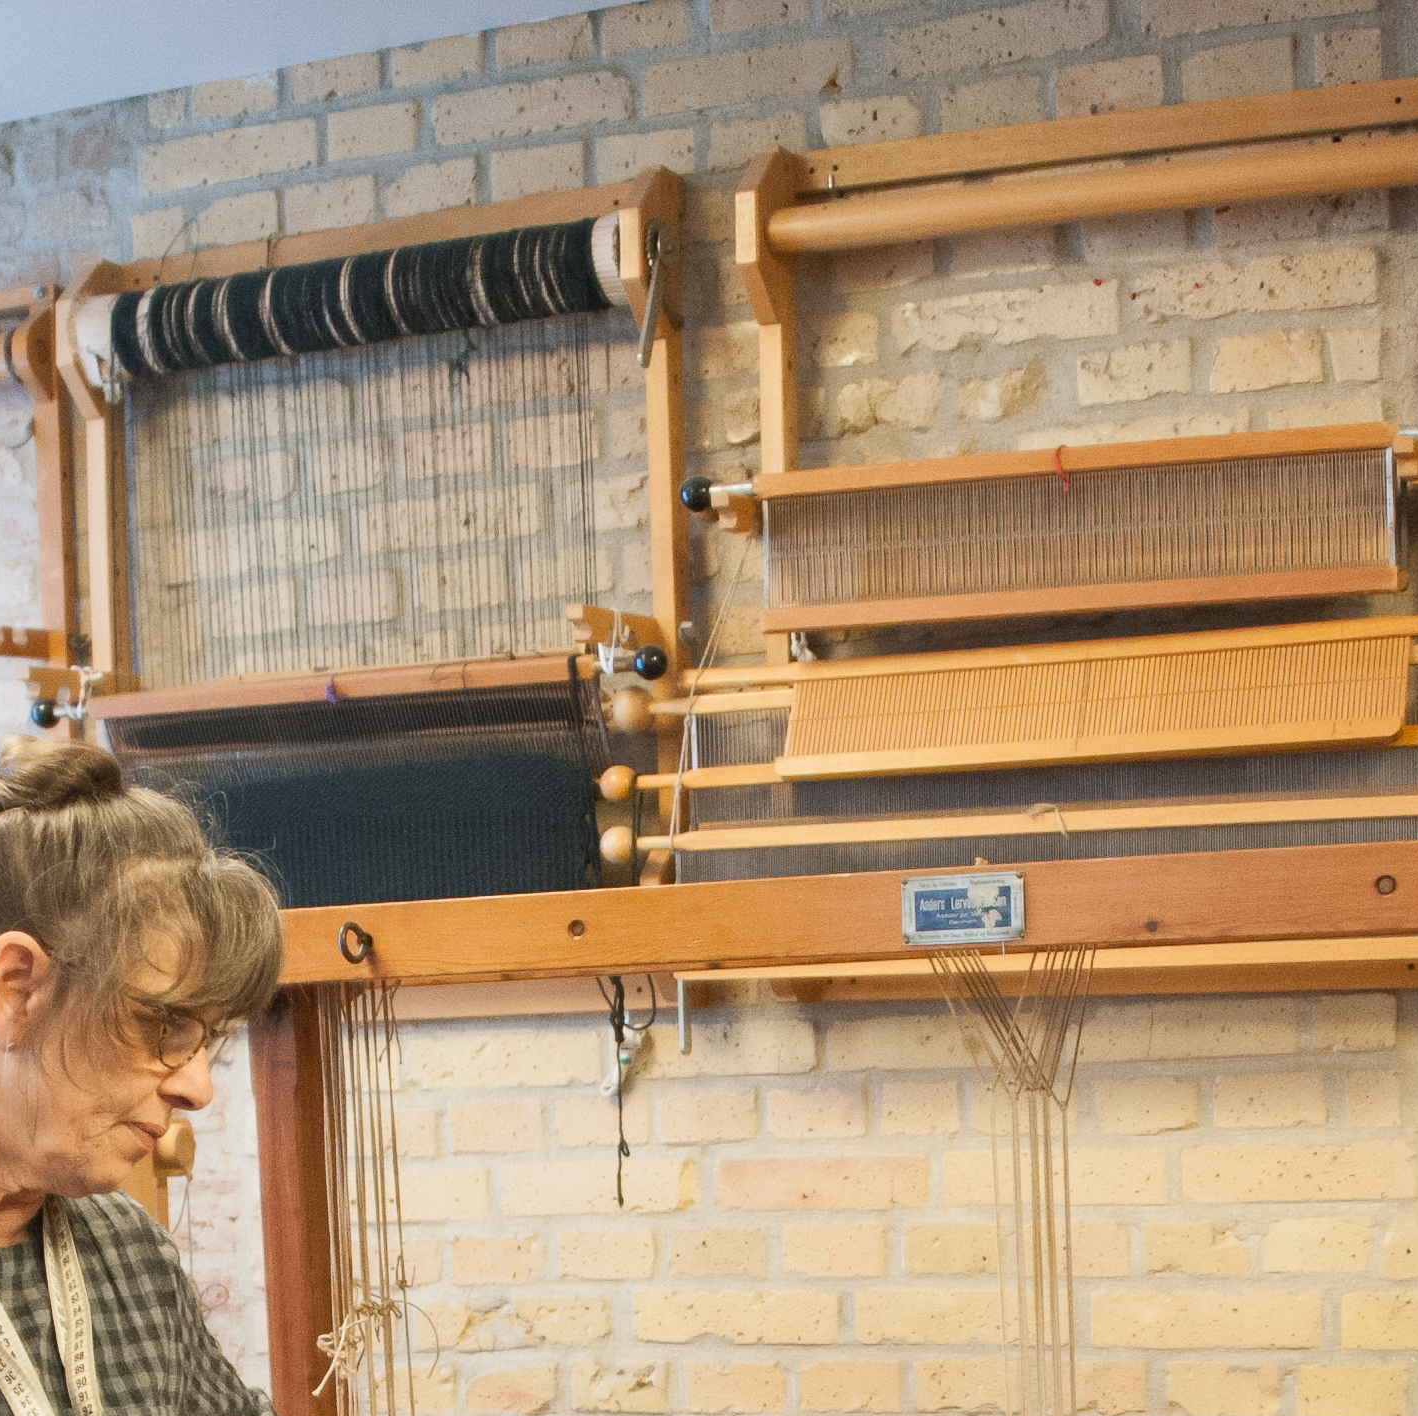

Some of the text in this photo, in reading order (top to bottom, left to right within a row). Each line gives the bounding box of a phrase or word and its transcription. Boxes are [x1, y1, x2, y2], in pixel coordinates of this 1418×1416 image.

[920, 898, 945, 911] Anders
[5, 1370, 16, 1384] 36
[76, 1376, 87, 1388] 90
[13, 1383, 25, 1396] 35
[20, 1396, 33, 1408] 34
[79, 1390, 89, 1402] 91
